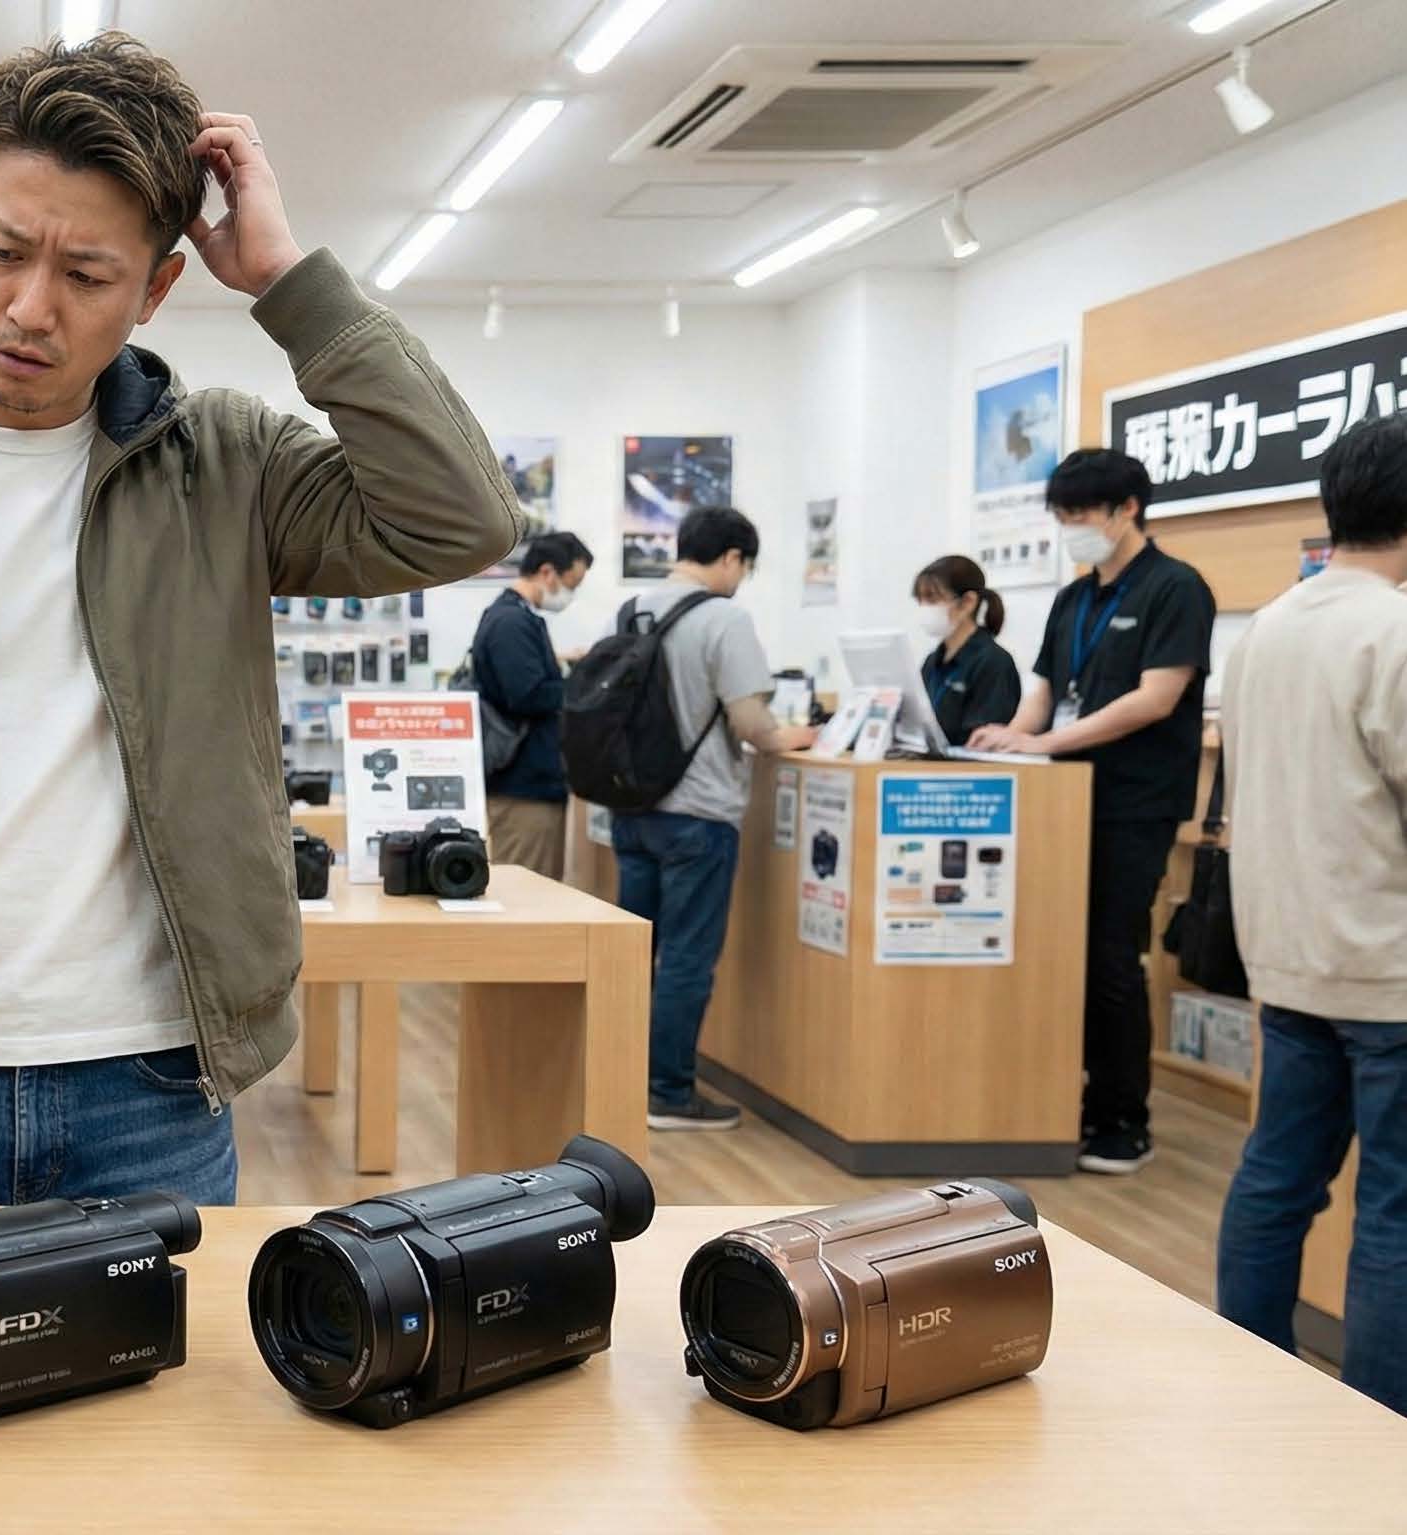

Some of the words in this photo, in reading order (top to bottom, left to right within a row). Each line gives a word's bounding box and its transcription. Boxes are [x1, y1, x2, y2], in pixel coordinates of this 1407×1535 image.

[558, 1228, 598, 1251] SONY
[107, 1256, 157, 1277] SONY
[994, 1250, 1037, 1272] SONY
[0, 1305, 66, 1336] FDX
[899, 1306, 953, 1337] HDR
